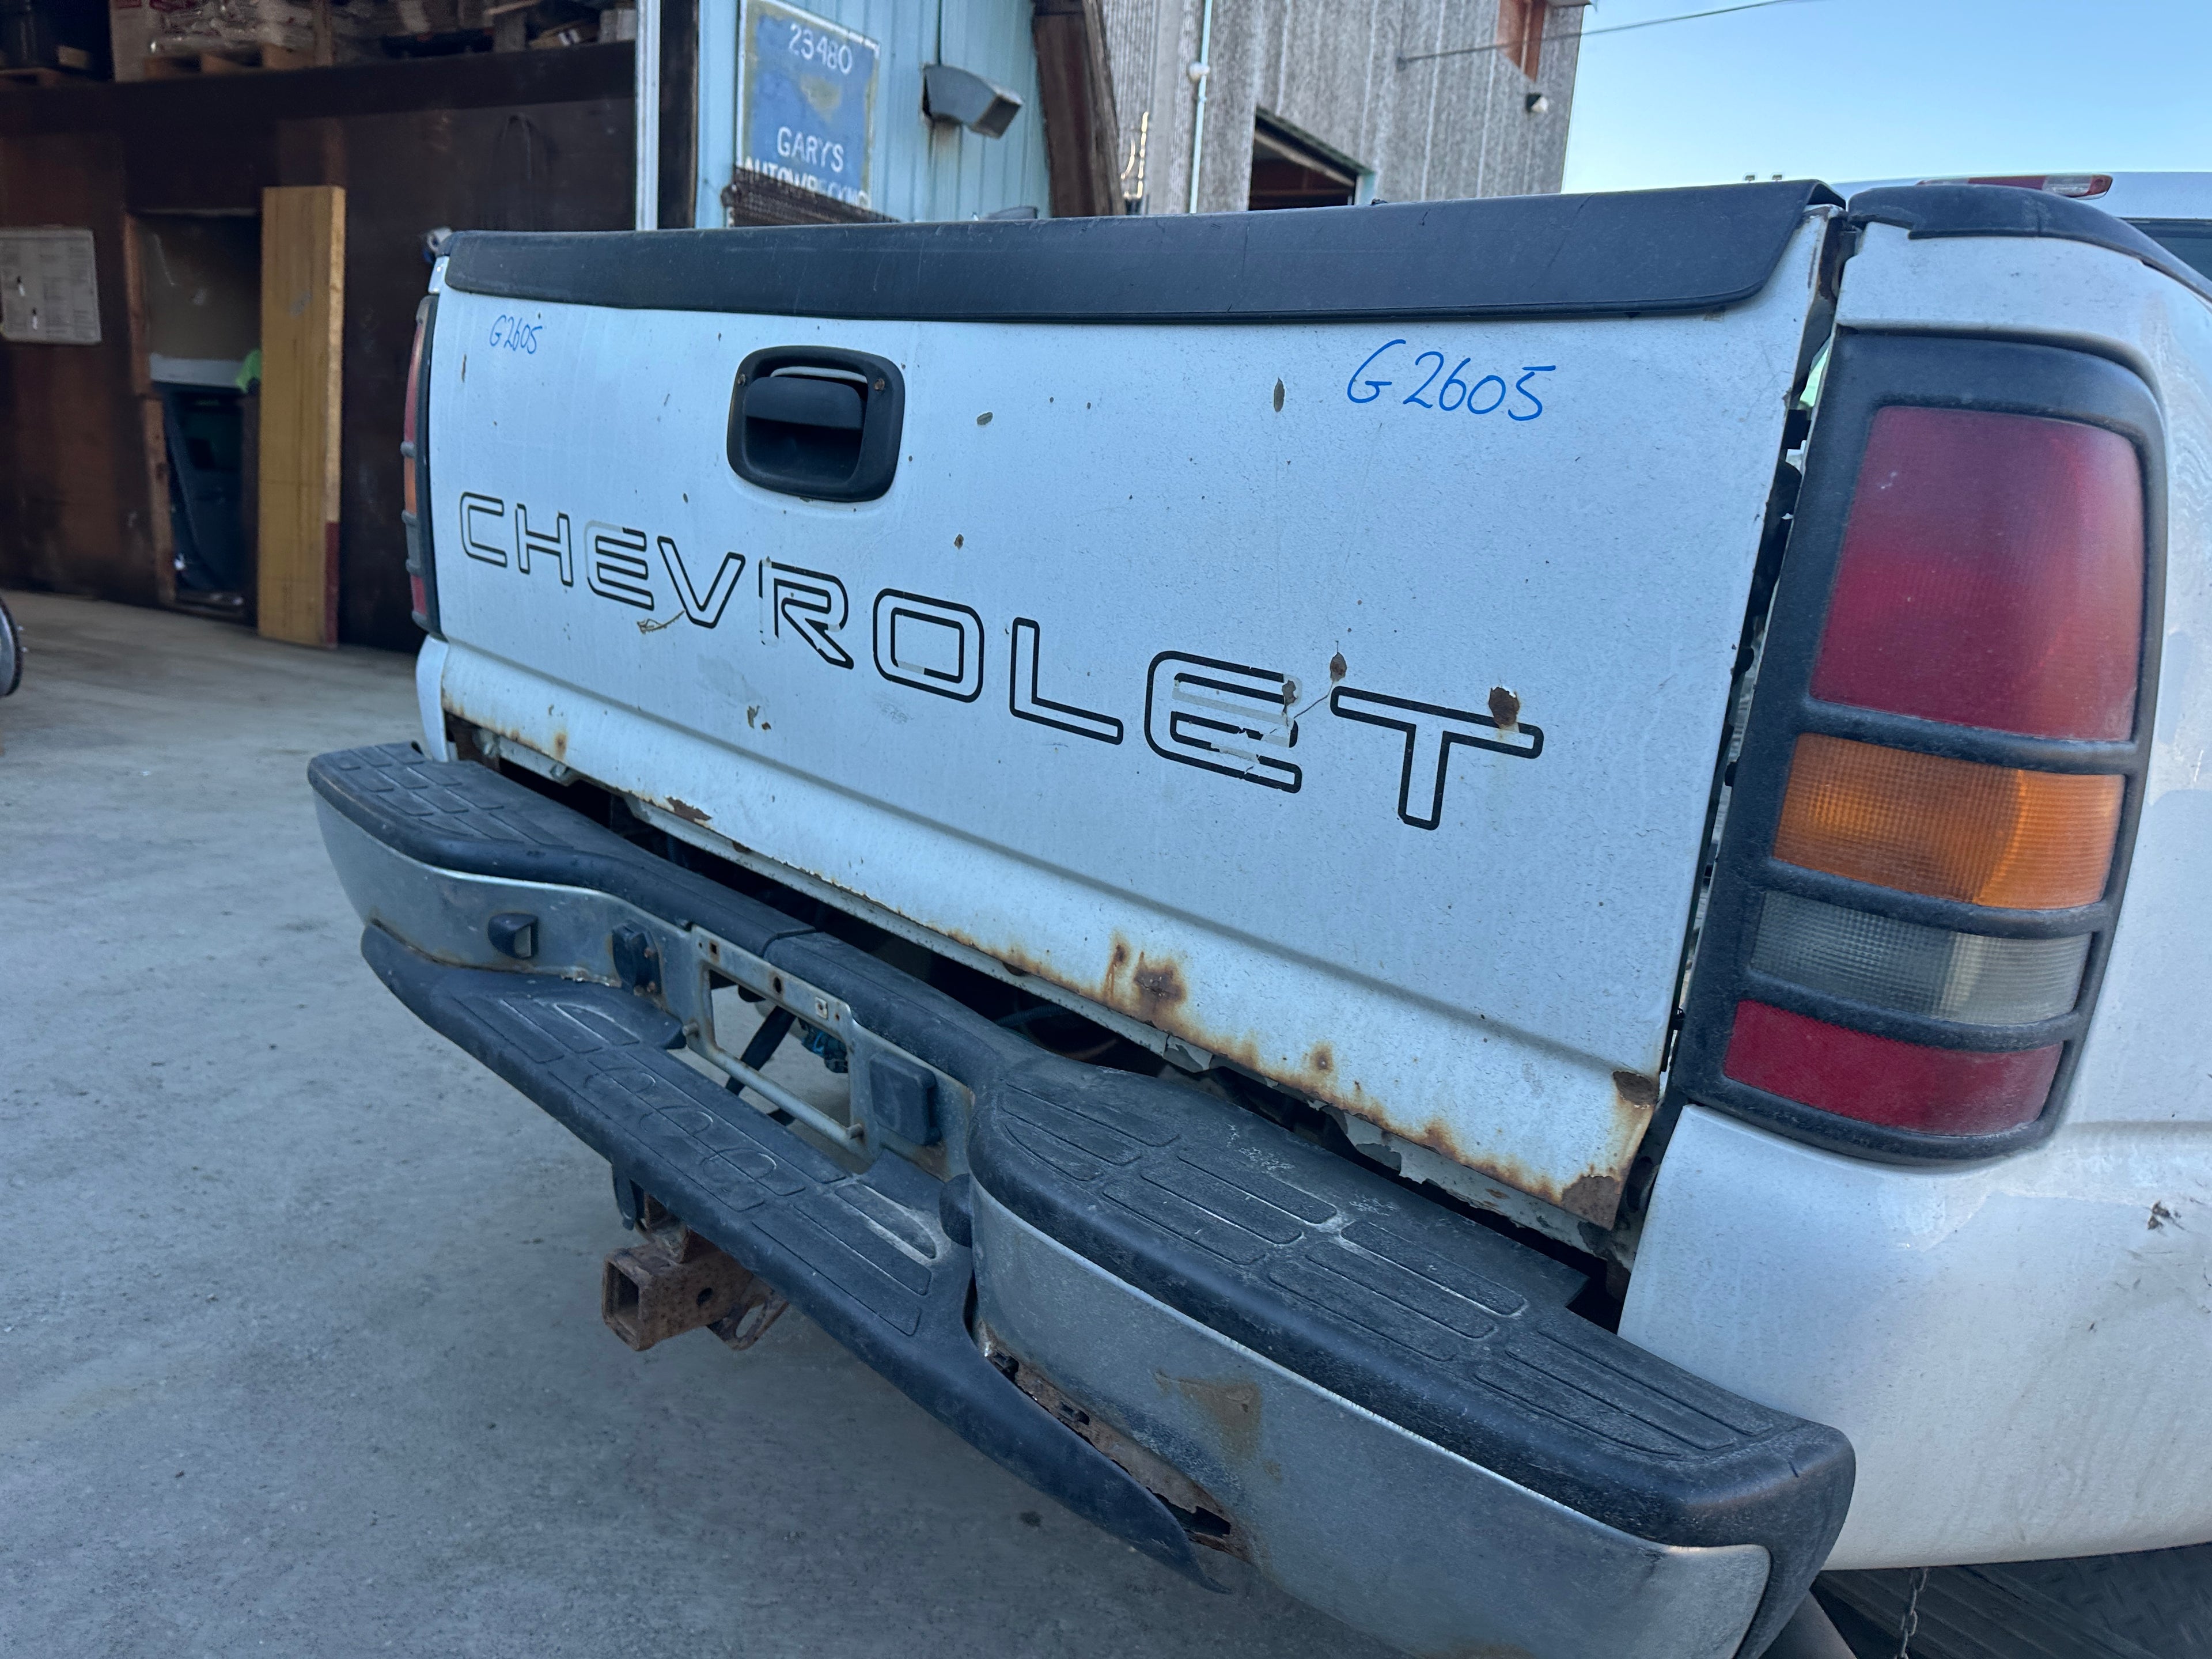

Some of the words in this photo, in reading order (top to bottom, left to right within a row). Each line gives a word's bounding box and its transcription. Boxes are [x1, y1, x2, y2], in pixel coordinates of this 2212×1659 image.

[789, 23, 853, 74] 23480
[490, 315, 543, 354] G2605
[1347, 339, 1556, 421] G2605
[460, 491, 1544, 831] CHEVROLET
